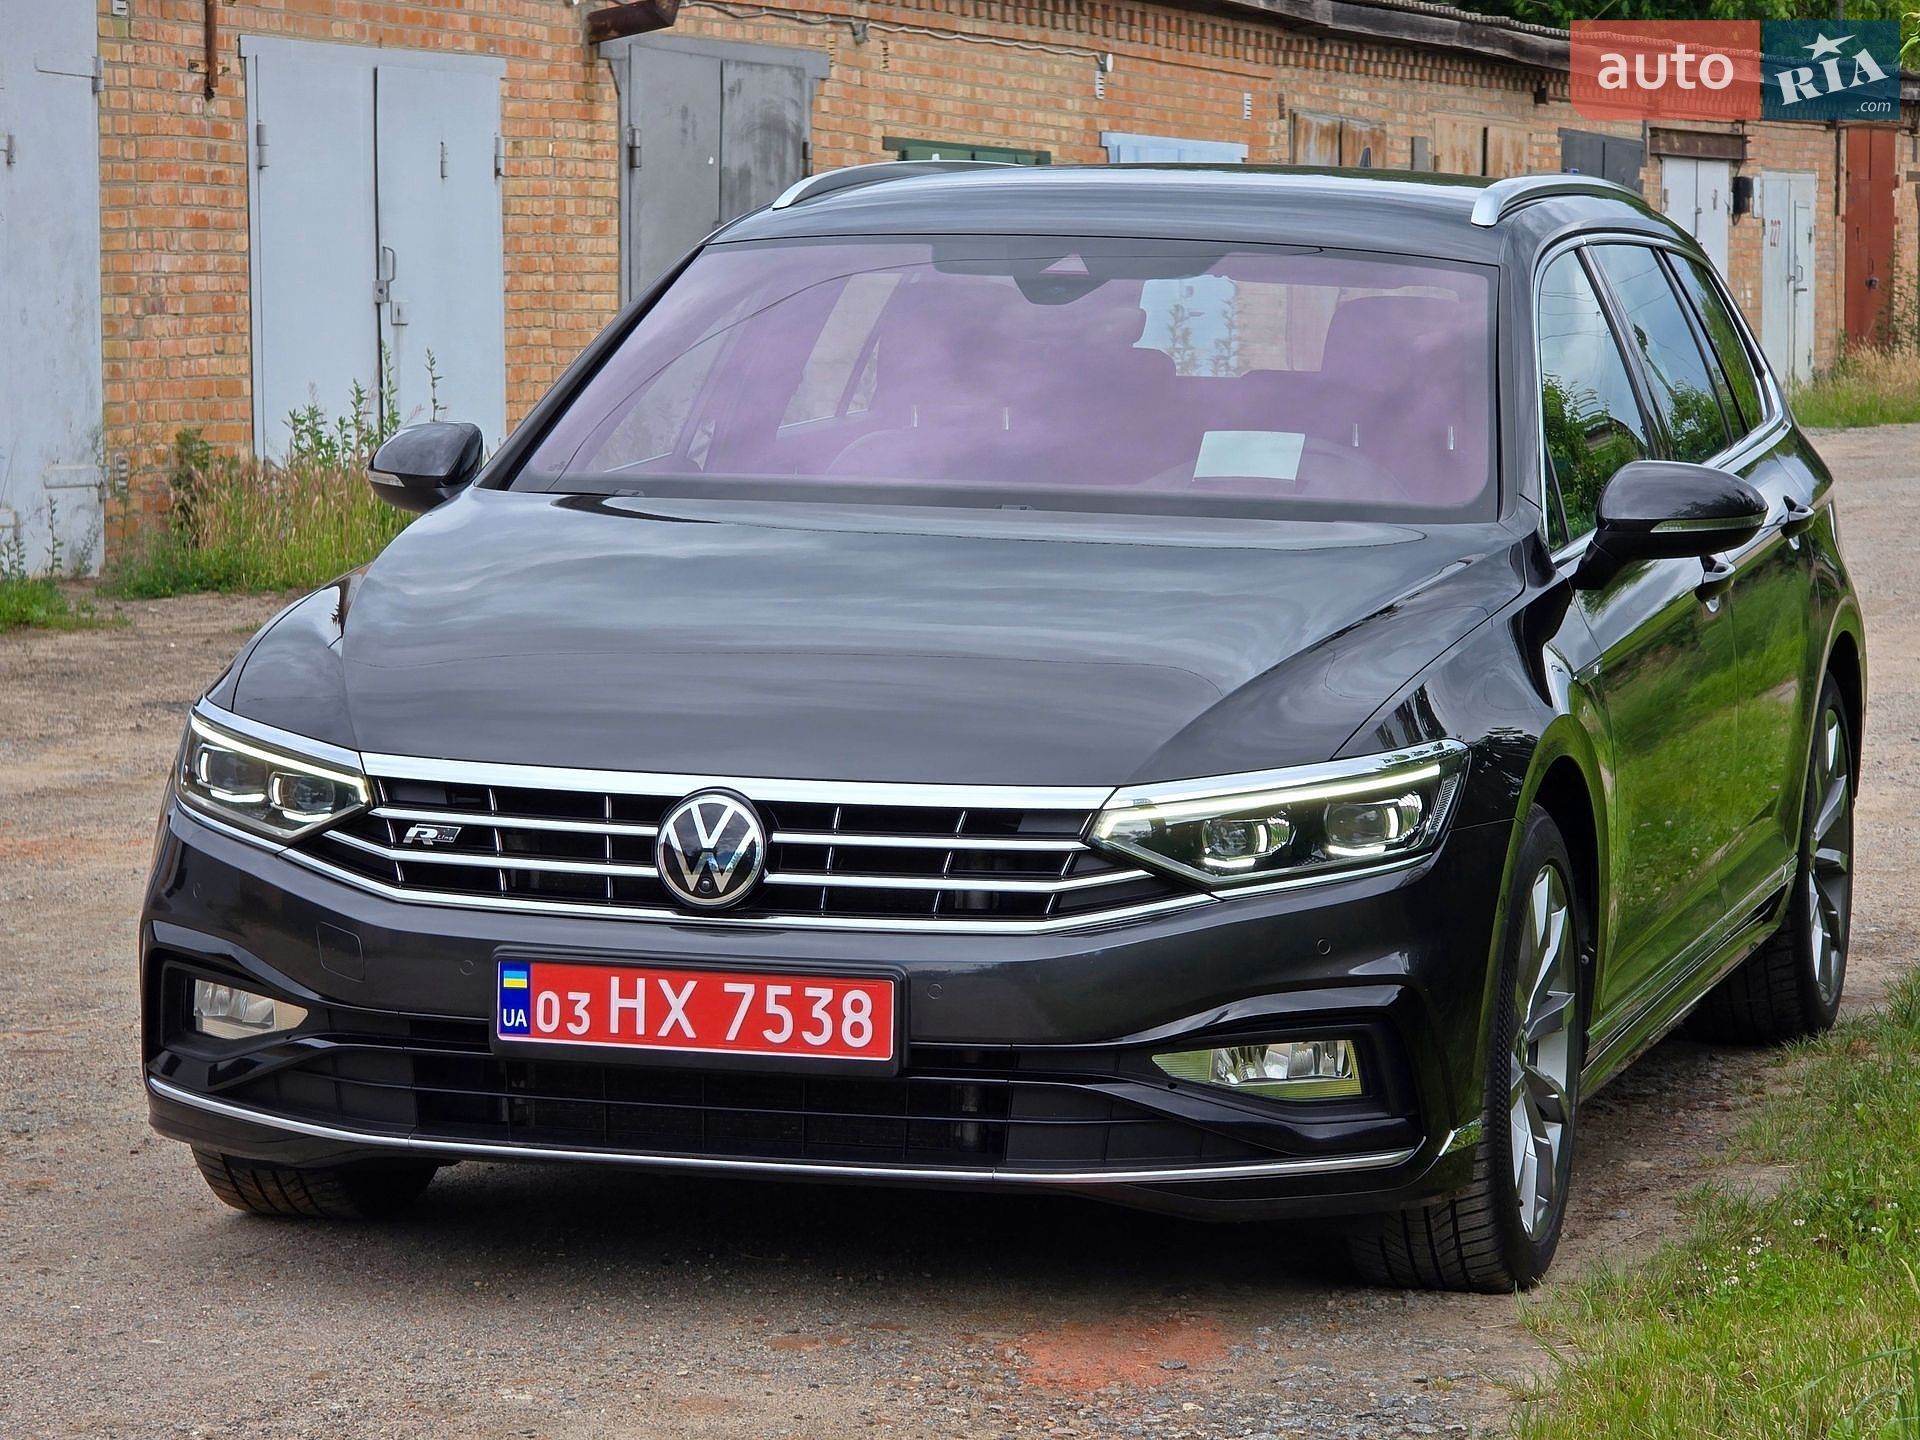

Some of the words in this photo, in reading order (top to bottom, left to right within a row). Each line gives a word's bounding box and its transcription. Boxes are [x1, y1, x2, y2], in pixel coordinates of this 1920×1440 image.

[402, 826, 438, 846] R
[503, 1008, 528, 1028] UA
[536, 990, 590, 1035] 03
[609, 976, 698, 1039] HX
[723, 982, 873, 1048] 7538
